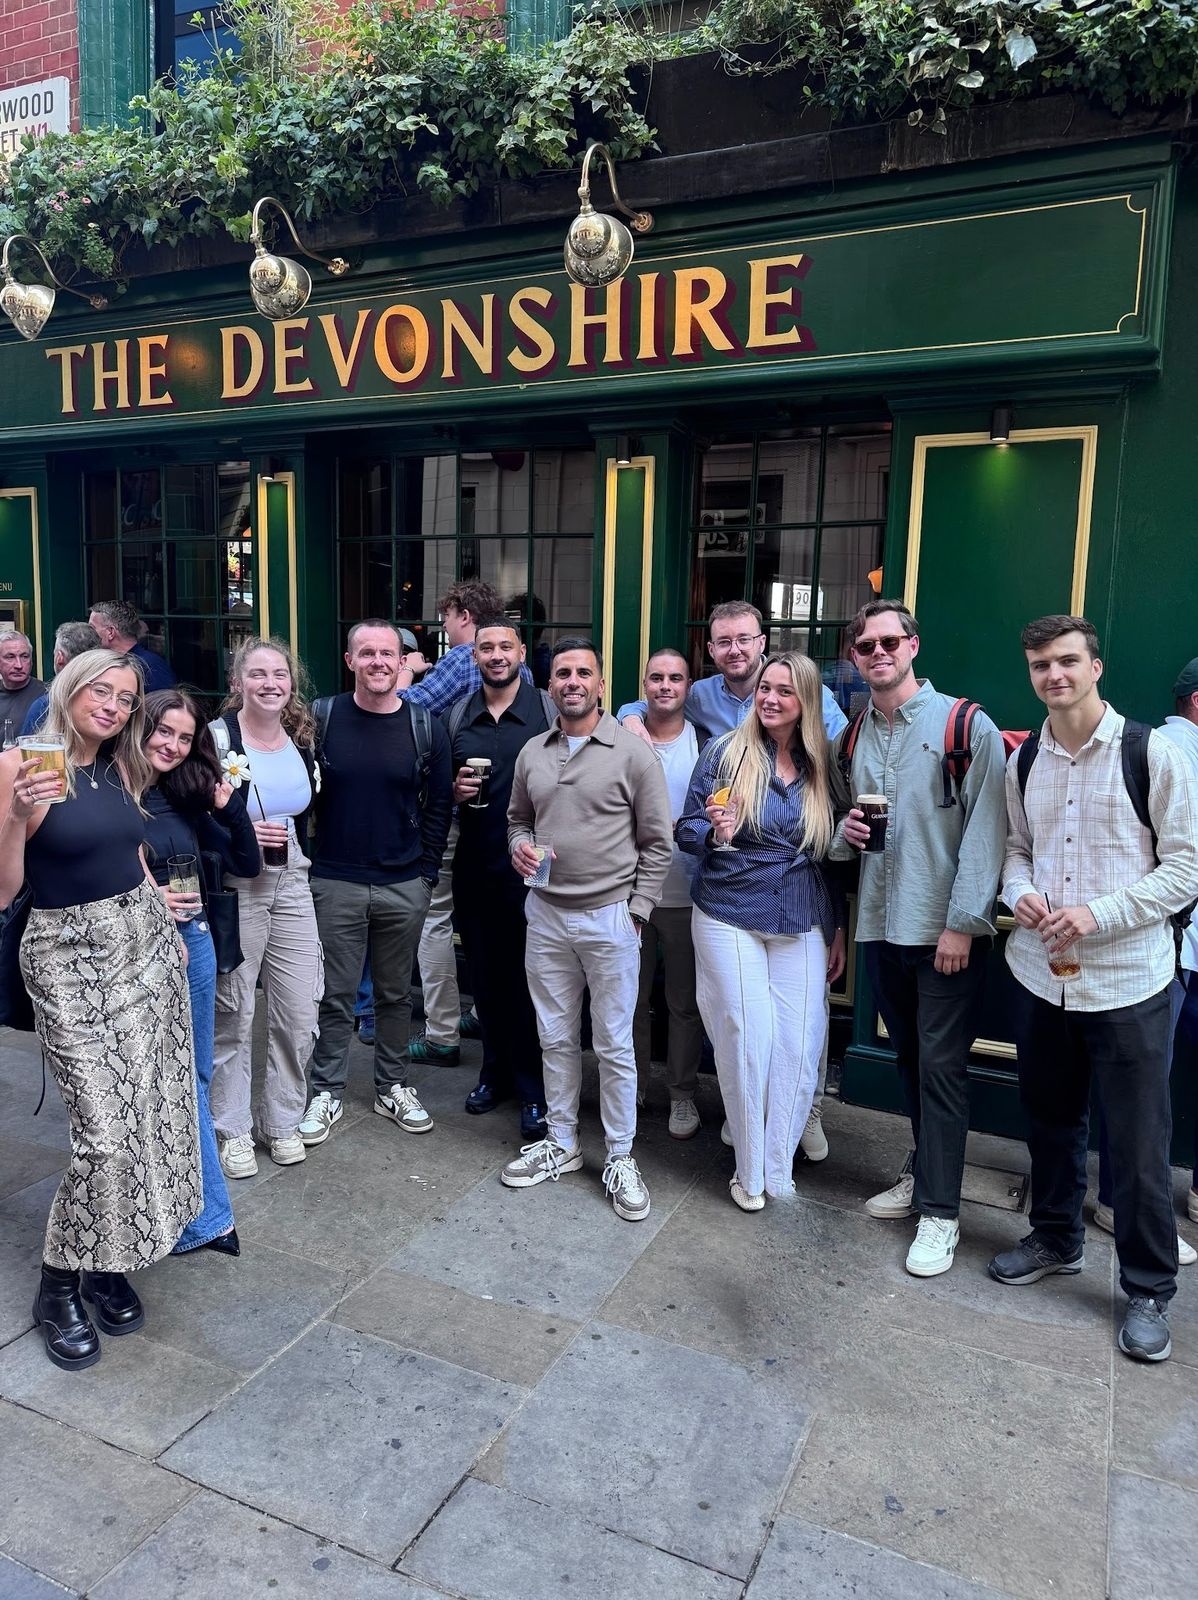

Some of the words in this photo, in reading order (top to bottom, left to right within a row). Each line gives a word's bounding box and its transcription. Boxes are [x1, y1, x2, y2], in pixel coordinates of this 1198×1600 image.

[0, 91, 53, 123] WOOD
[45, 334, 174, 414] THE
[220, 252, 806, 400] DEVONSHIRE
